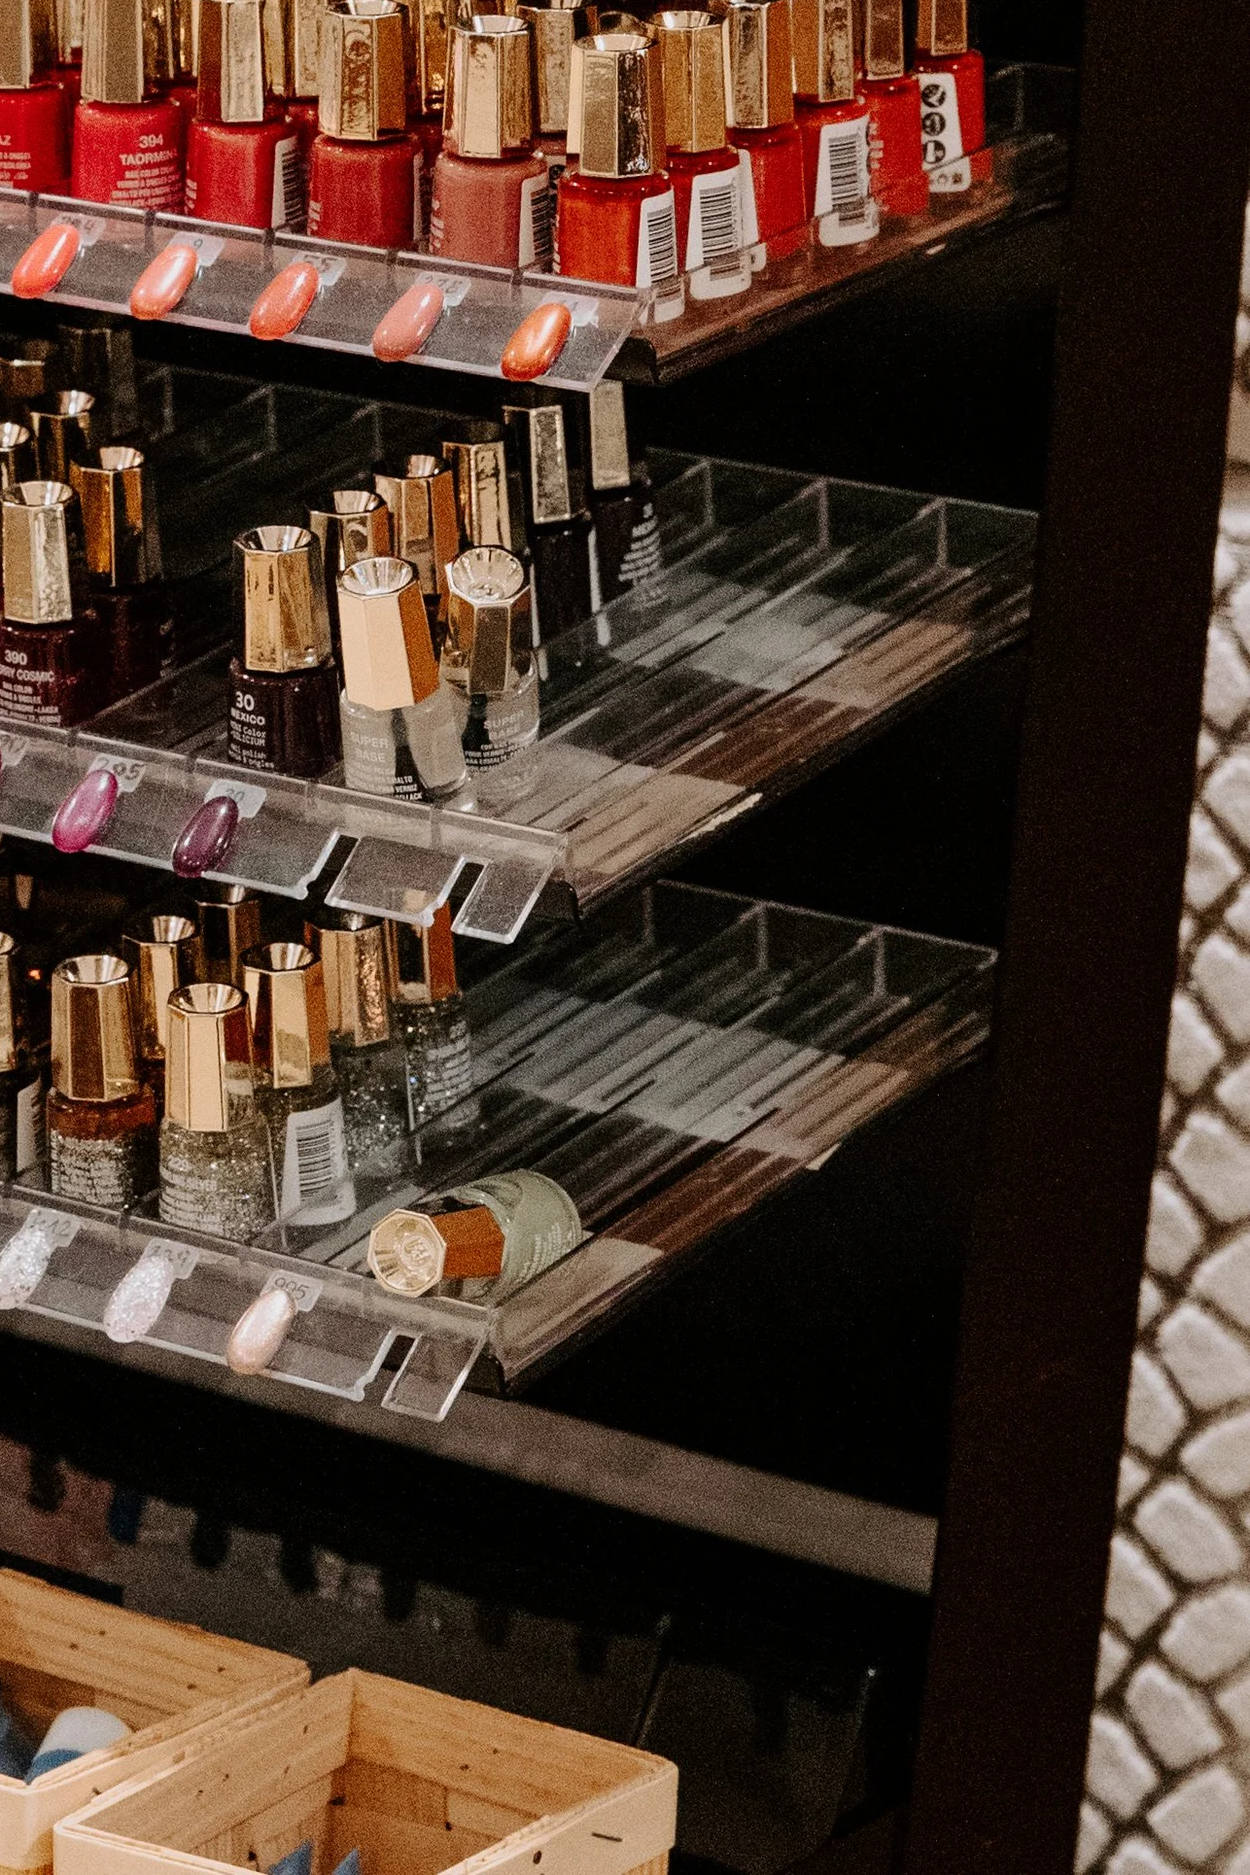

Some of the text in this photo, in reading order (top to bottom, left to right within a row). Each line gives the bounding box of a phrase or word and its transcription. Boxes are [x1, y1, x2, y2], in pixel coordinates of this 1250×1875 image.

[4, 649, 28, 665] 390
[16, 668, 55, 682] COSMIC
[235, 691, 255, 711] 30
[230, 707, 266, 726] MEXICO
[351, 731, 389, 749] SUPER
